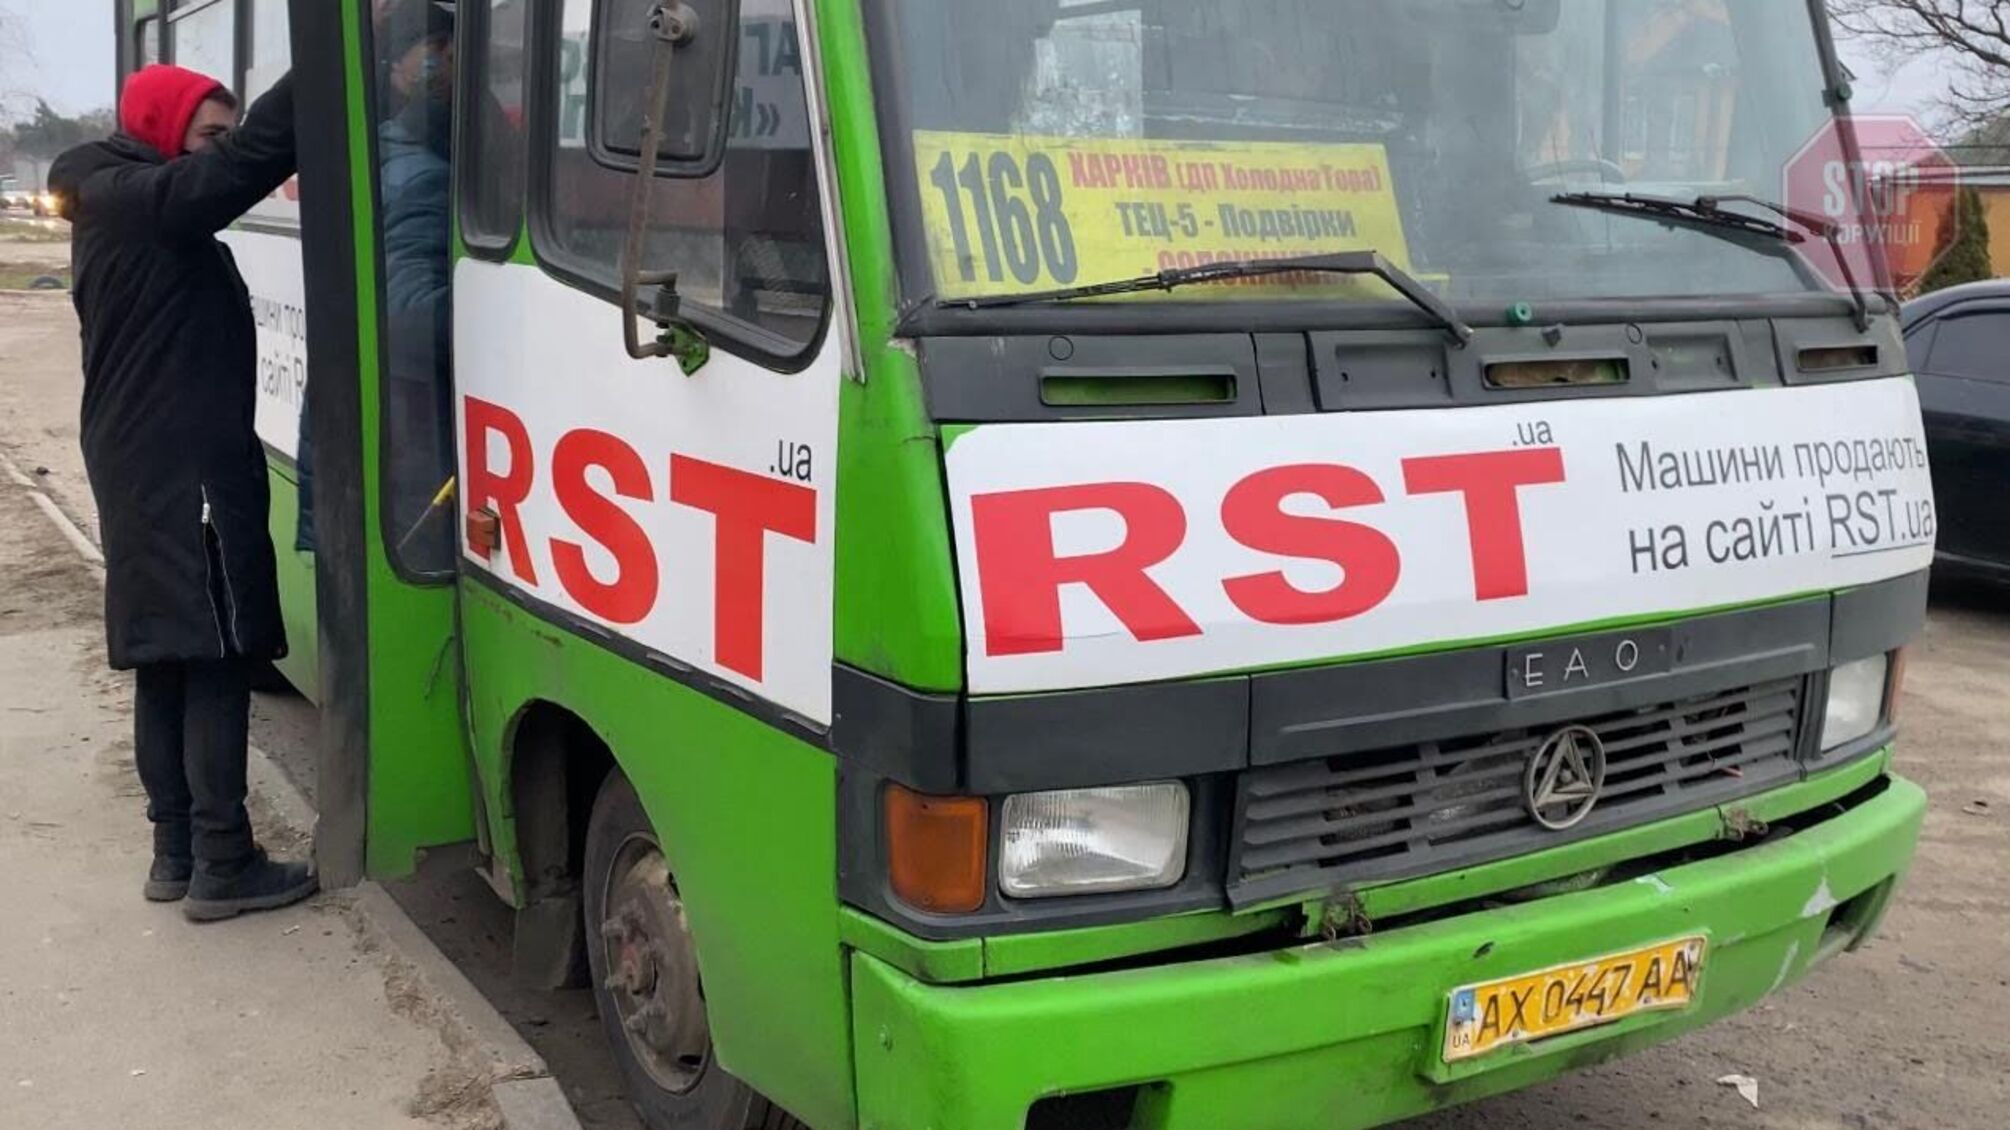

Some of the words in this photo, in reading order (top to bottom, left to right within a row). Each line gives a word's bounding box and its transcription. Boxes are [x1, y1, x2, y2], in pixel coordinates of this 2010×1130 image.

[1067, 152, 1172, 189] ХАРКІВ
[929, 150, 1078, 285] 1168
[1115, 202, 1198, 242] ТЕЦ-5
[1217, 203, 1358, 241] Подвірки
[769, 439, 813, 482] .ua
[1512, 420, 1554, 447] .ua
[1615, 441, 1785, 493] Машини
[1795, 437, 1926, 488] продають
[464, 394, 817, 683] RST
[971, 447, 1566, 657] RST
[1629, 524, 1688, 574] на
[1706, 497, 1815, 564] сайті
[1825, 489, 1933, 550] RST.ua
[1477, 986, 1534, 1042] AX
[1542, 964, 1634, 1024] 0447
[1452, 1033, 1470, 1048] UA
